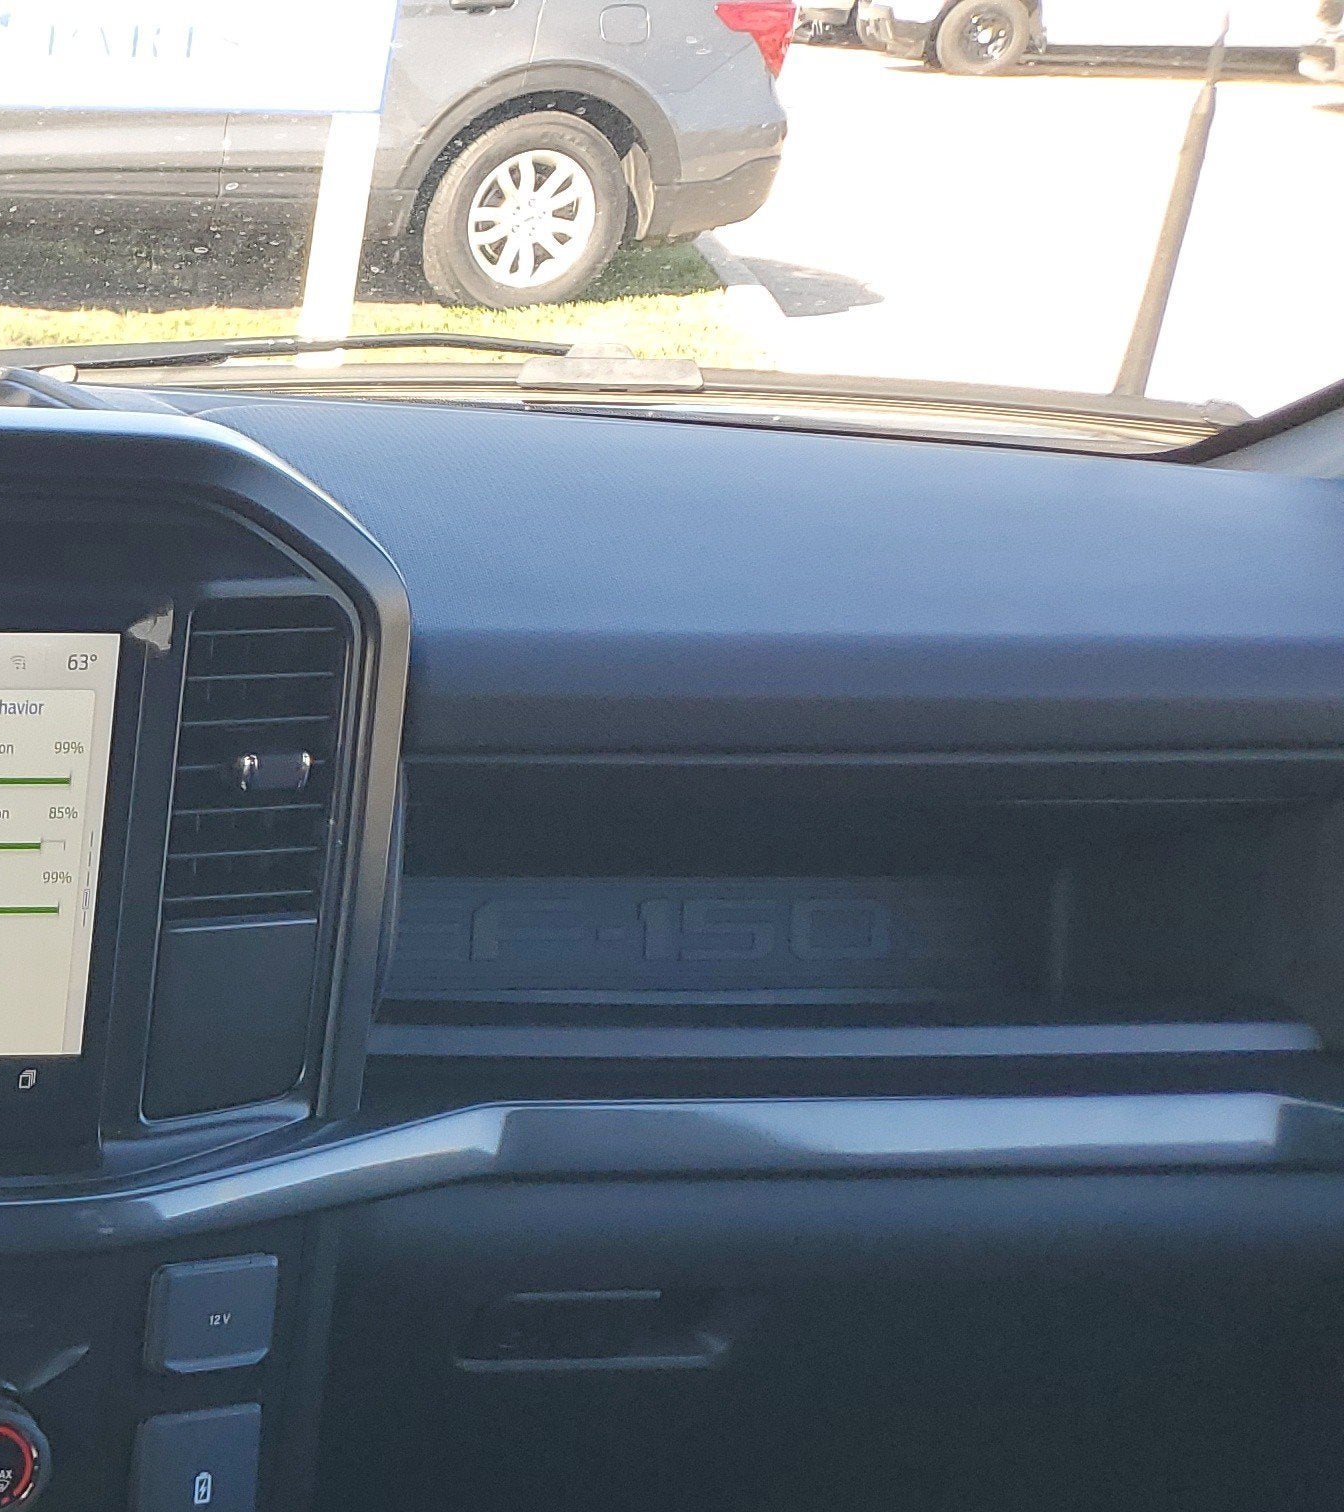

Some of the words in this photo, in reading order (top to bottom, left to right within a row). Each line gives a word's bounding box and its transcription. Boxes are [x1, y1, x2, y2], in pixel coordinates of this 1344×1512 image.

[67, 652, 99, 672] 63°
[53, 740, 85, 755] 99%
[48, 805, 79, 821] 85%
[42, 870, 73, 885] 99%
